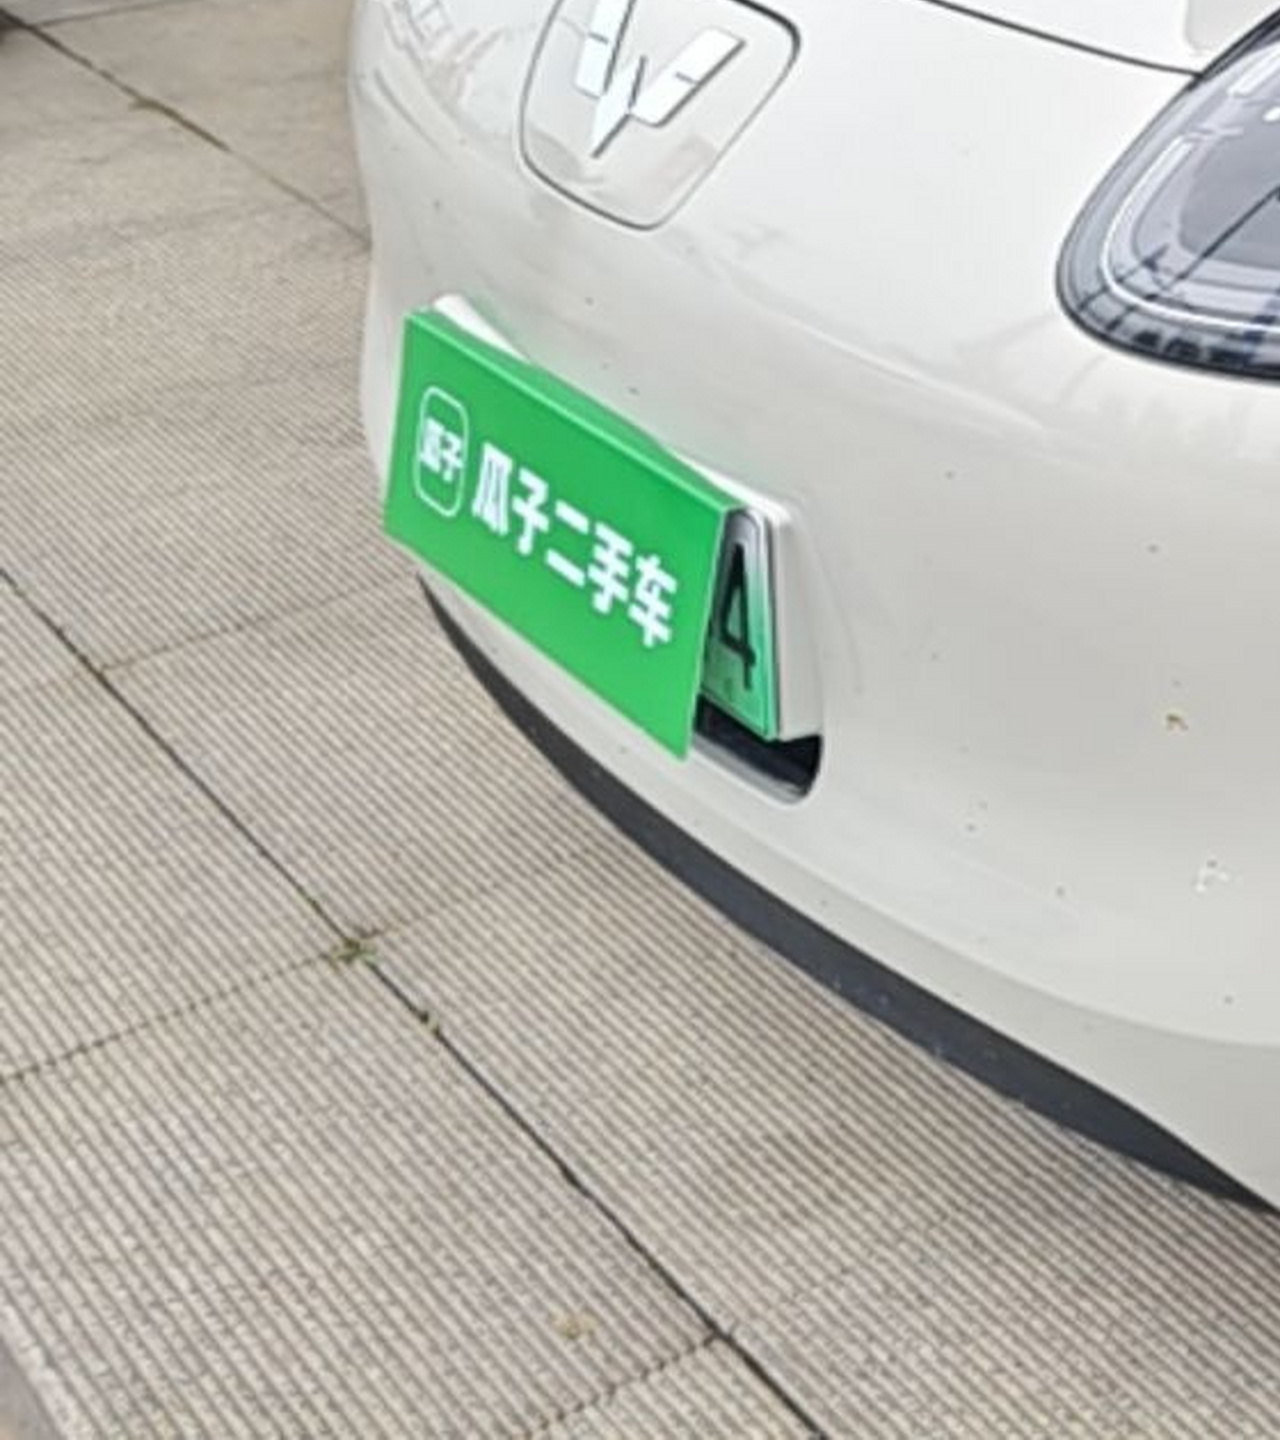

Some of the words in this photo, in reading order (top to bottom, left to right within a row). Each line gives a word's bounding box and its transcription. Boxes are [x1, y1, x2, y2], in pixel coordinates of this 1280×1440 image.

[472, 442, 677, 648] 瓜子二手车
[721, 542, 757, 691] 4
